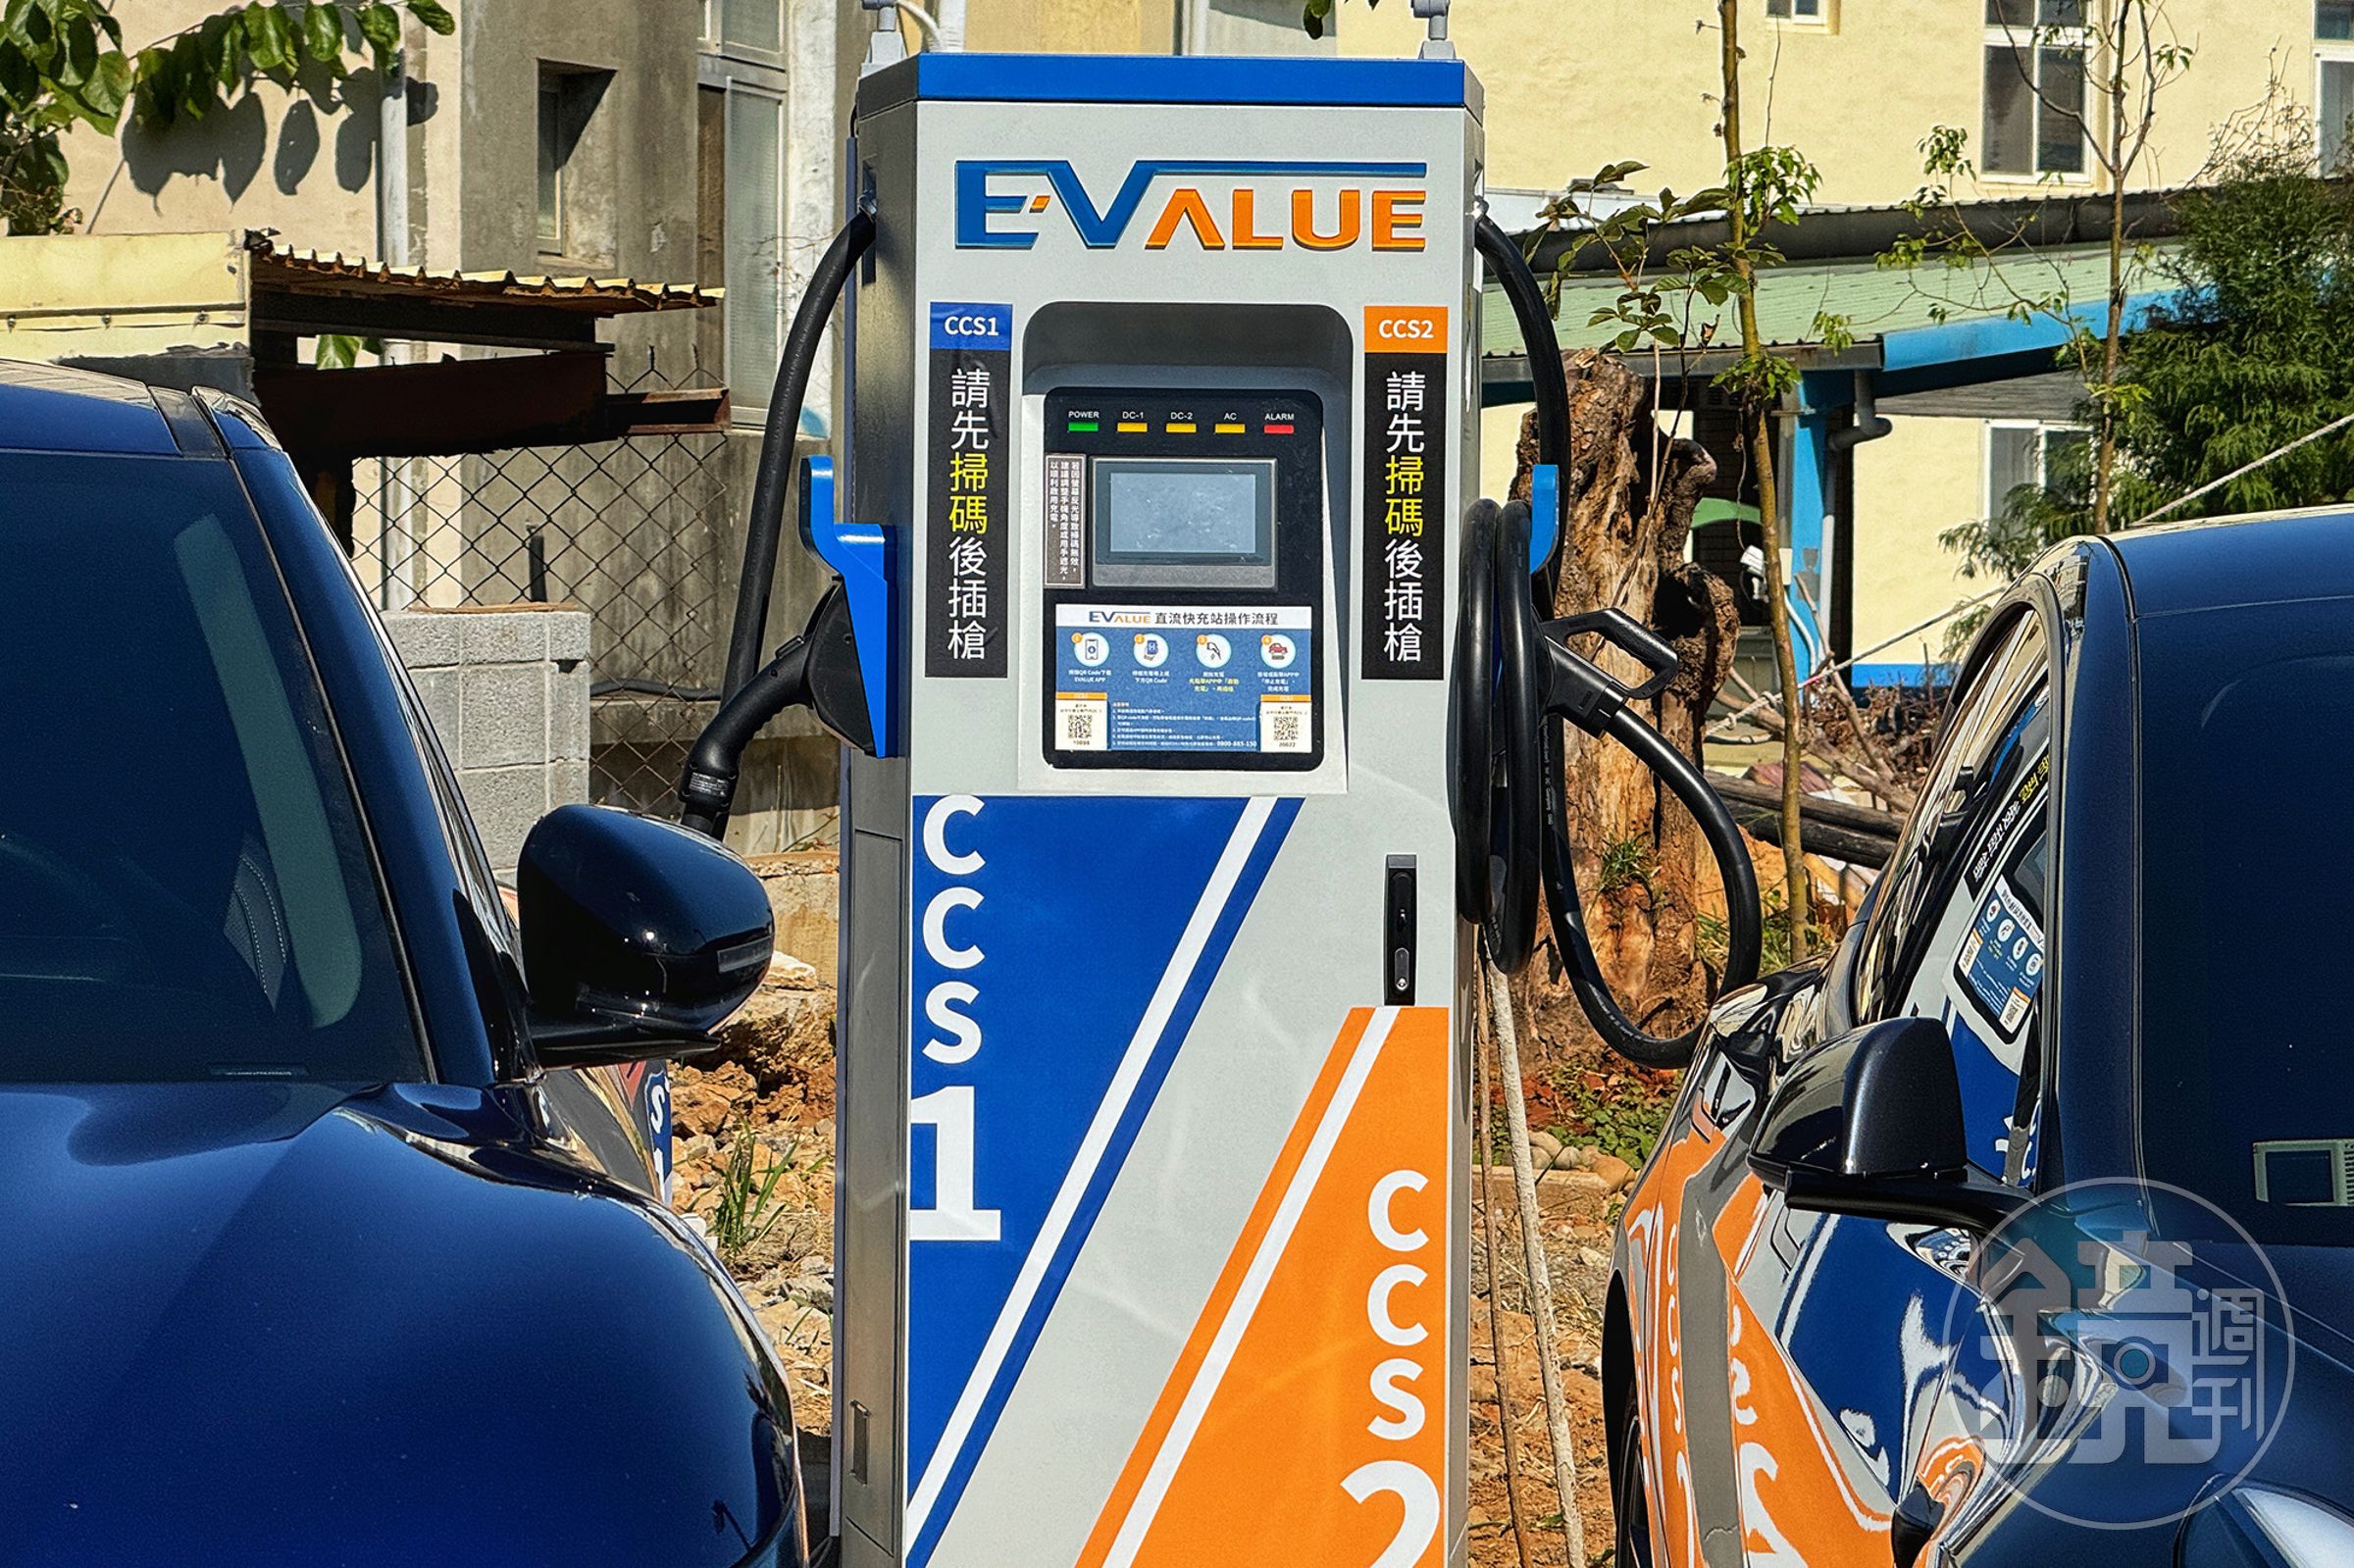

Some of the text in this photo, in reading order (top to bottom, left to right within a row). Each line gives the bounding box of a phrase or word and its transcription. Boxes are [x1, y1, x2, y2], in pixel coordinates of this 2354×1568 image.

[954, 160, 1427, 252] EVALUE
[944, 316, 999, 336] CCS1
[1378, 319, 1435, 339] CCS2
[1122, 411, 1145, 420] DC-1
[1223, 412, 1238, 421] AC
[947, 368, 991, 660] 請先掃碼後插槍
[1383, 371, 1426, 662] 請先掃碼後插槍
[1089, 611, 1279, 625] EVALUE 直流快充站操作流程
